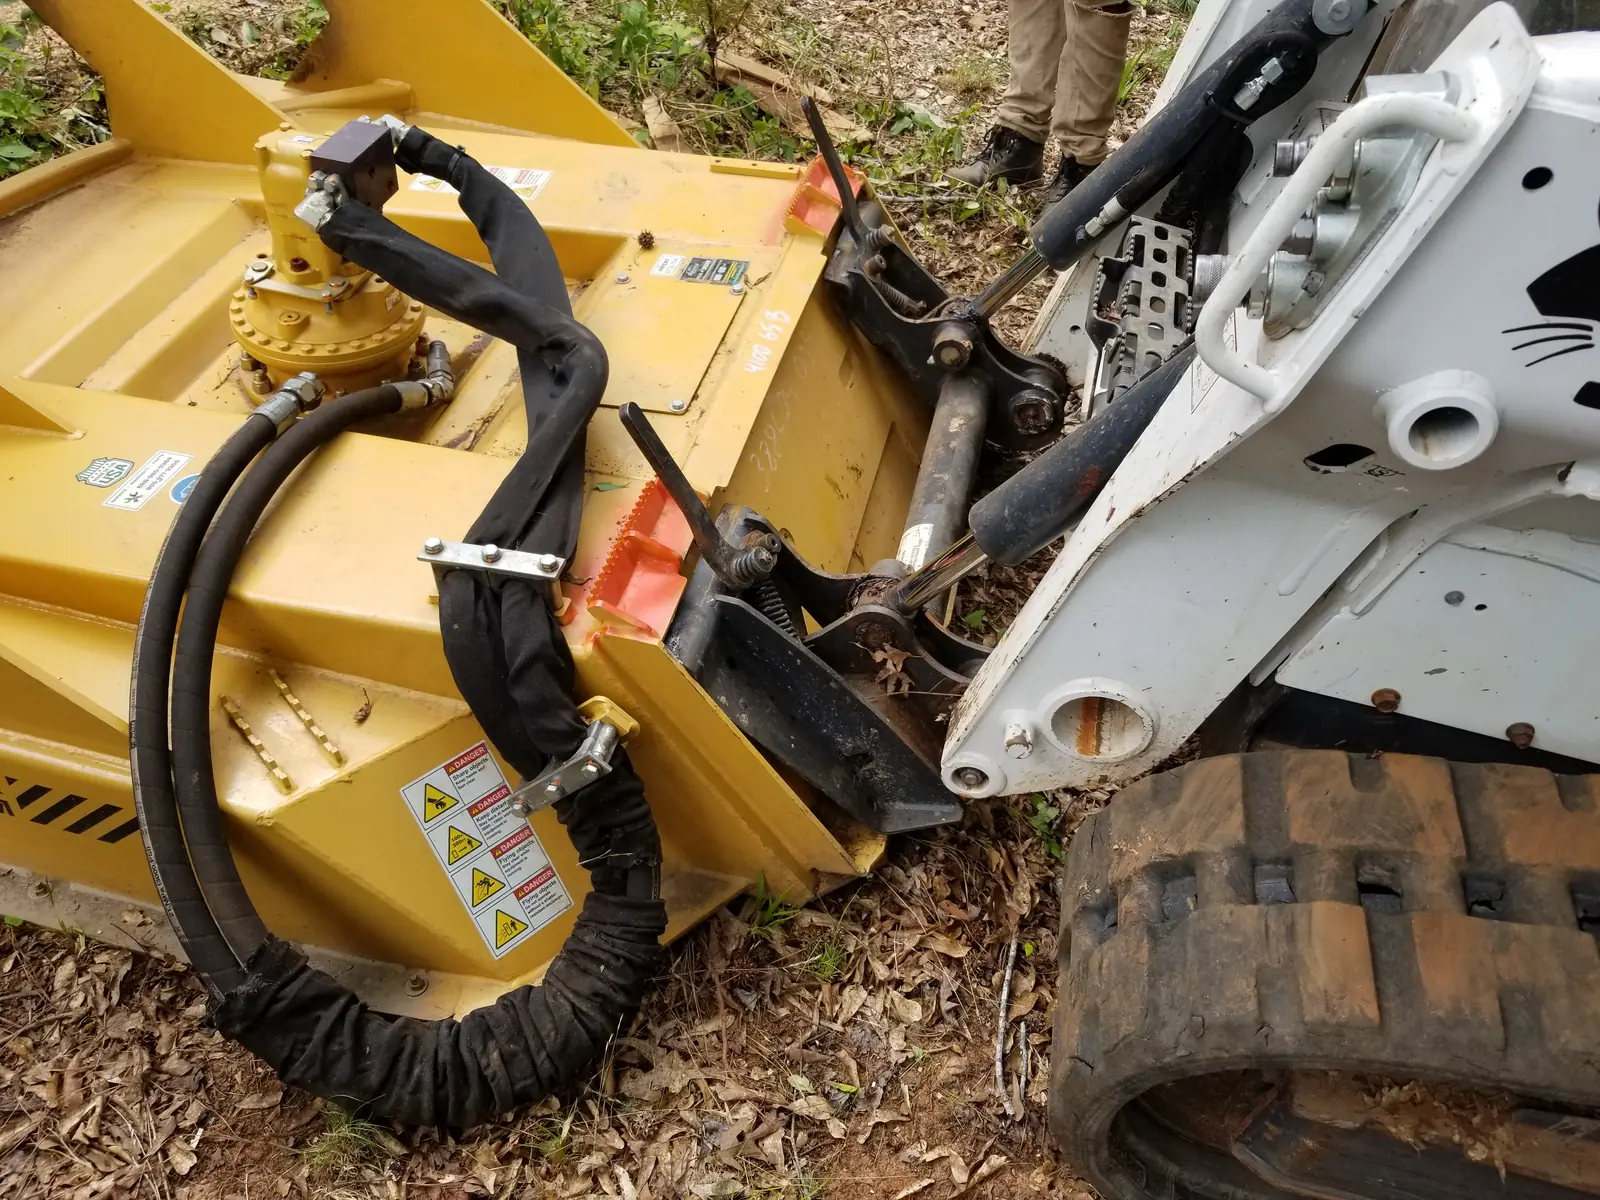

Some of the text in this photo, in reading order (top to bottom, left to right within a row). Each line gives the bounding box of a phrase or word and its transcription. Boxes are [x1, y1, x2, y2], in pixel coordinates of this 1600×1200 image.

[98, 464, 128, 484] USA
[454, 746, 486, 768] DANGER
[452, 758, 488, 780] Sharp objects
[477, 788, 508, 810] DANGER
[476, 812, 490, 822] Keep
[500, 829, 532, 852] DANGER
[499, 840, 534, 864] Flying objects
[523, 870, 554, 892] DANGER
[522, 880, 557, 906] Flying objects
